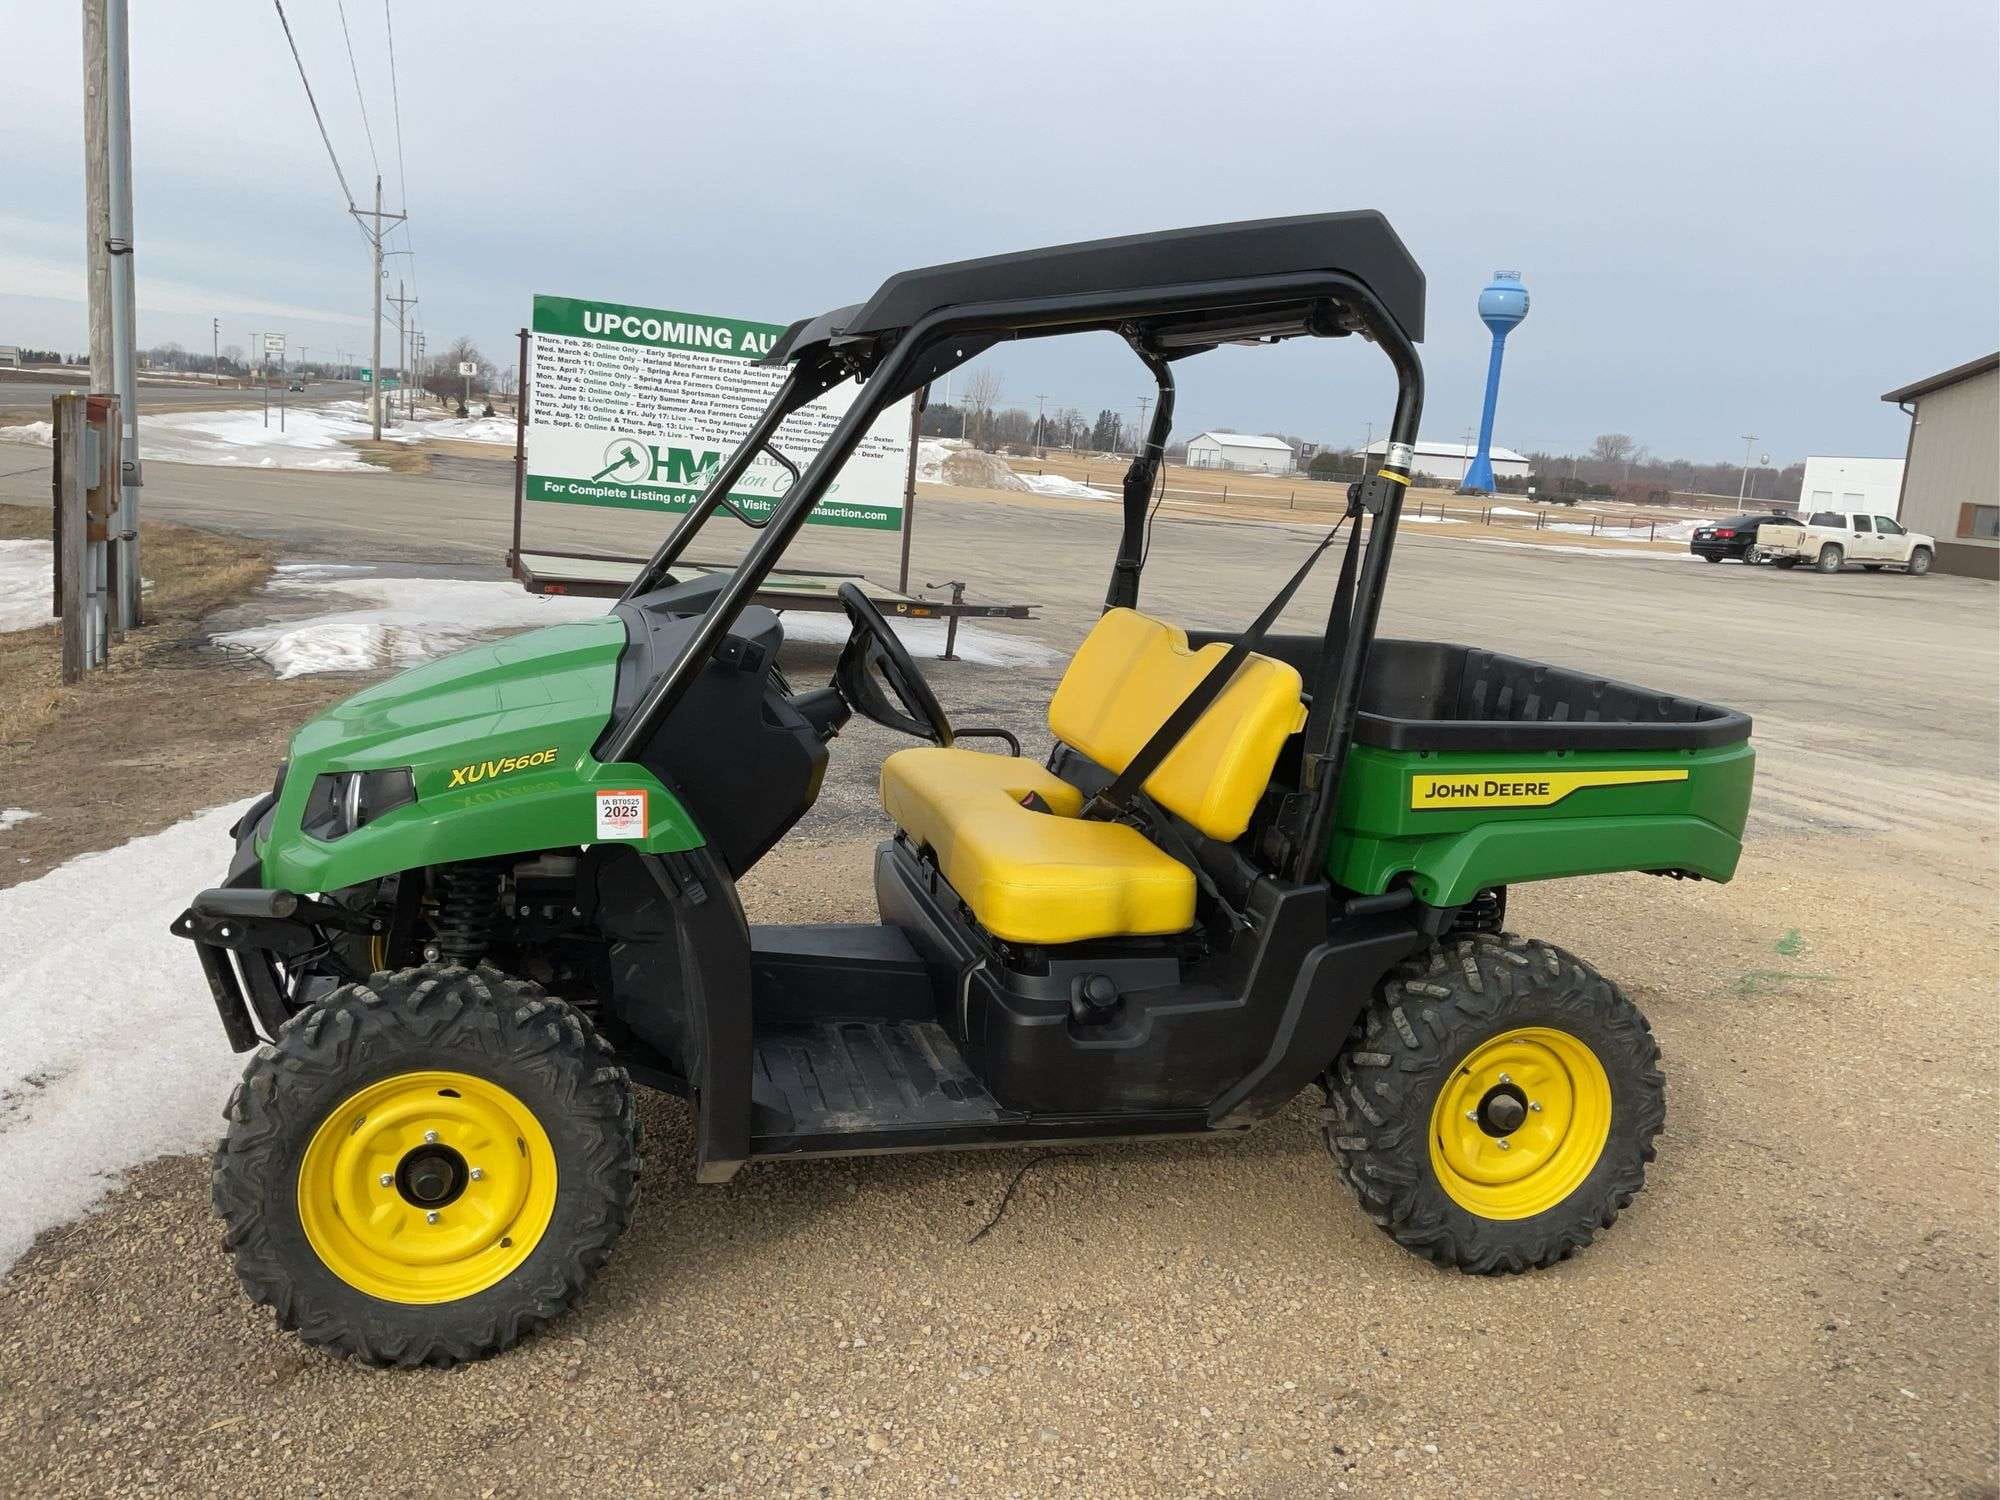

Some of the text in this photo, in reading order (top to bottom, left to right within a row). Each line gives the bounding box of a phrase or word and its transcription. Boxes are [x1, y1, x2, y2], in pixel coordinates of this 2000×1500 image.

[583, 311, 776, 354] UPCOMING AU
[537, 336, 561, 344] Thurs.
[595, 343, 619, 351] Online
[621, 346, 638, 354] Only
[646, 349, 665, 357] Early
[667, 351, 690, 360] Spring
[711, 357, 740, 365] Farmers
[557, 347, 581, 355] March
[618, 355, 635, 363] Only
[642, 357, 671, 366] Harland
[536, 363, 557, 371] Tues.
[559, 366, 577, 374] April
[588, 369, 612, 377] Online
[614, 372, 631, 380] Only
[638, 375, 662, 384] Spring
[683, 380, 712, 388] Farmers
[715, 384, 760, 395] Consignment
[596, 361, 620, 369] Online
[622, 364, 639, 372] Only
[646, 367, 670, 376] Spring
[691, 372, 720, 380] Farmers
[722, 376, 768, 387] Consignment
[588, 387, 611, 395] Online
[614, 390, 630, 398] Only
[638, 393, 657, 401] Early
[659, 395, 689, 403] Summer
[609, 381, 626, 389] Only
[681, 389, 719, 399] Sportsman
[721, 393, 767, 404] Consignment
[561, 402, 577, 410] July
[636, 401, 654, 409] Early
[657, 404, 686, 412] Summer
[707, 409, 736, 417] Farmers
[552, 420, 573, 428] Sept.
[637, 428, 657, 436] Sept.
[555, 411, 572, 419] Aug.
[588, 414, 611, 422] Online
[647, 420, 663, 428] Aug.
[544, 481, 565, 492] For
[568, 483, 627, 499] Complete
[630, 489, 670, 503] Listing
[673, 493, 686, 502] of
[742, 499, 770, 510] Visit:
[447, 747, 558, 787] XUV560E
[1424, 781, 1550, 799] JOHN DEERE
[604, 806, 638, 818] 2025
